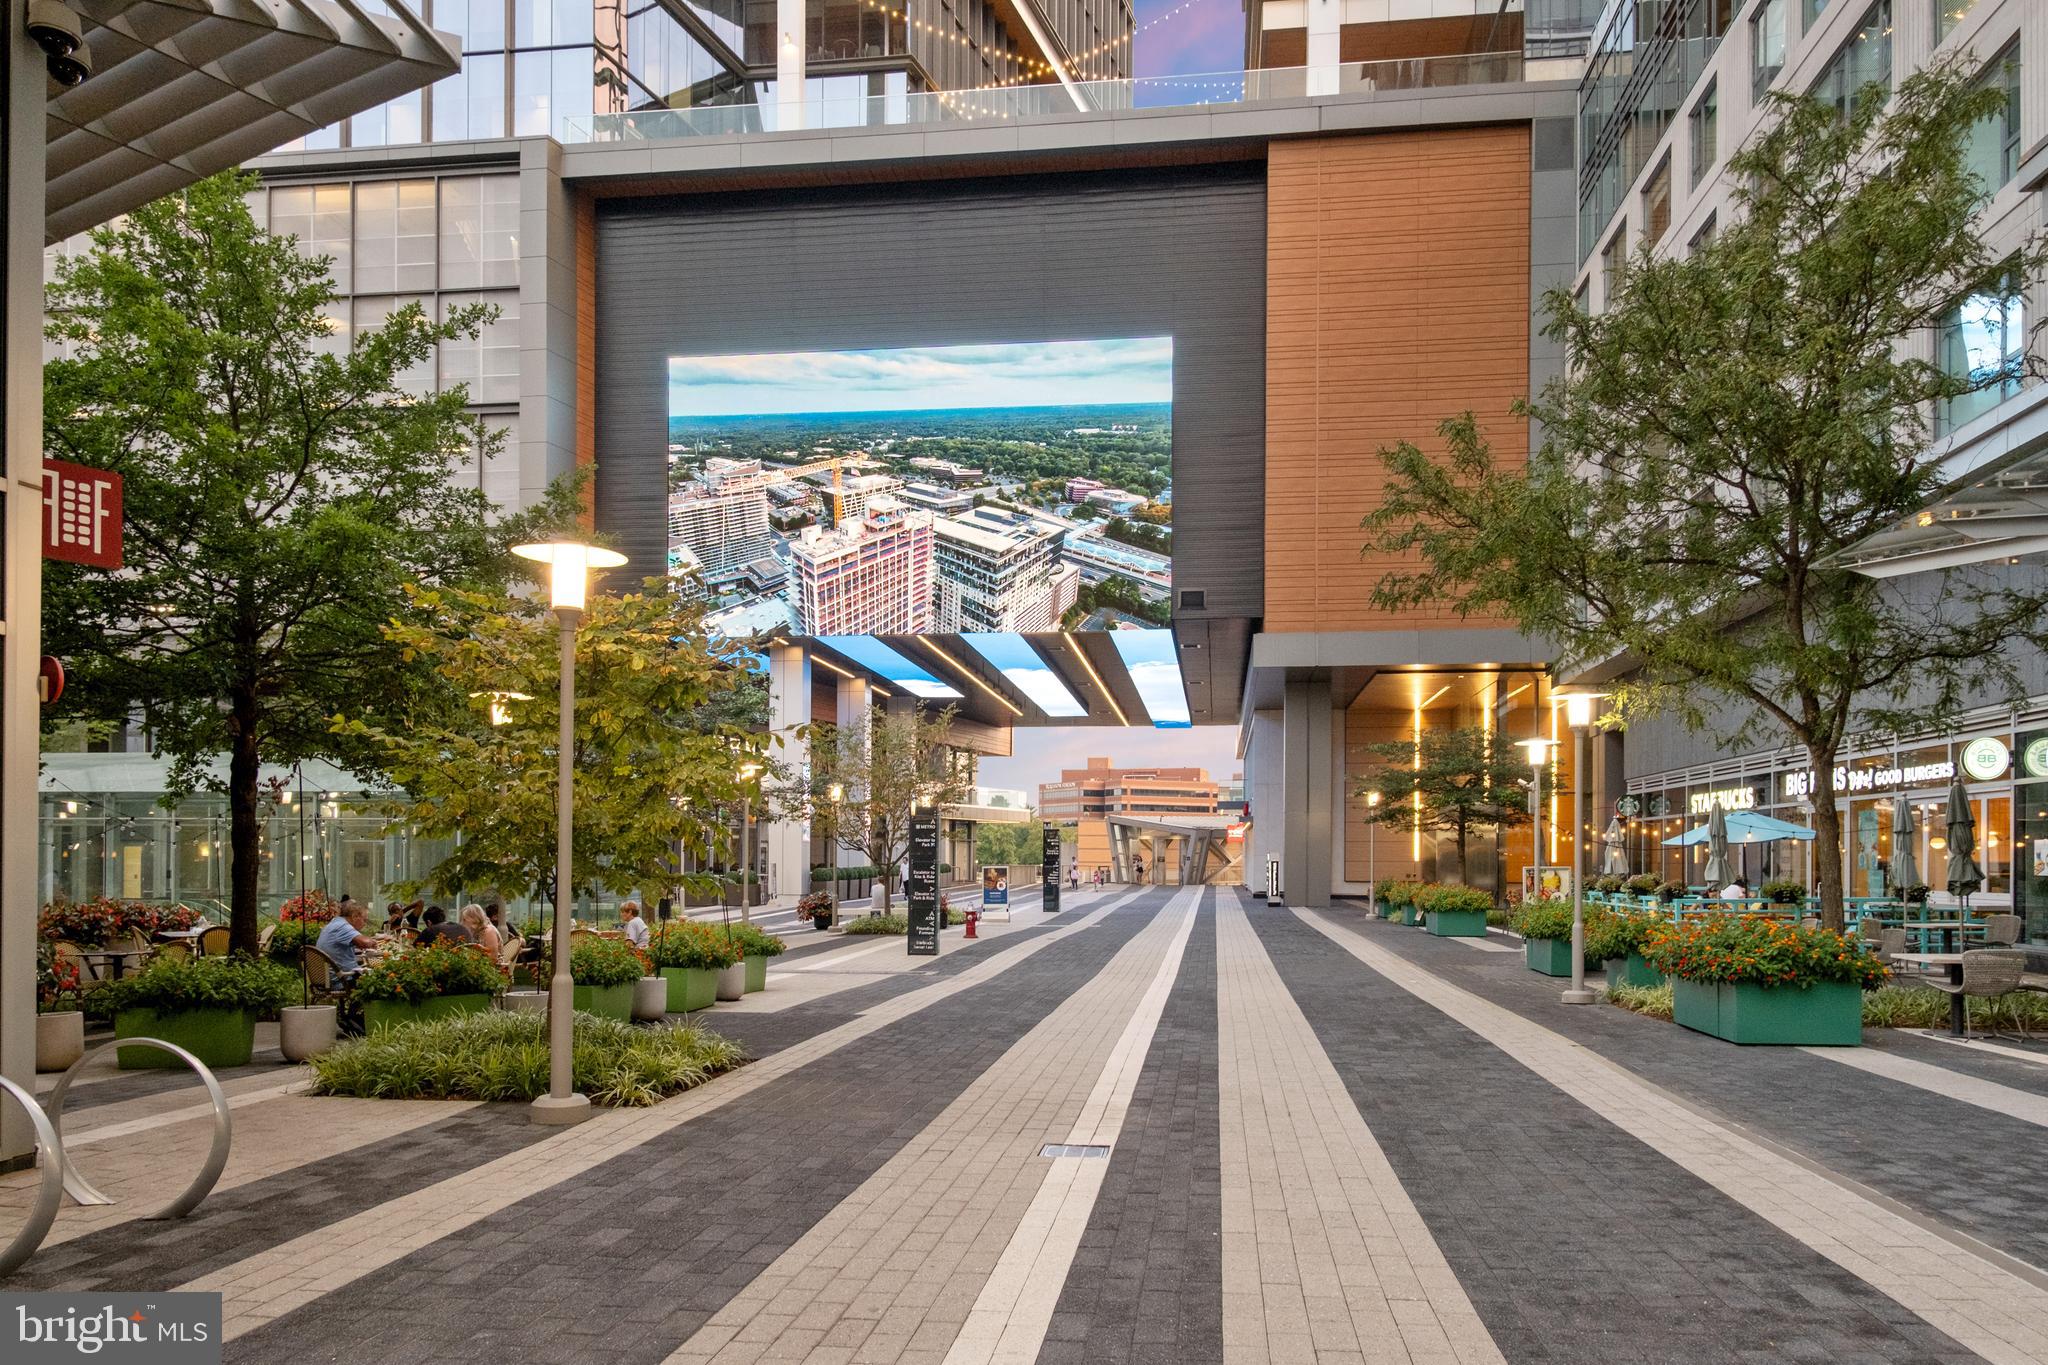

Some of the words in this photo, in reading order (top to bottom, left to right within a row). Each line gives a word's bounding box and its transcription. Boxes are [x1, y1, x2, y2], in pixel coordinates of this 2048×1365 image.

[1786, 772, 1807, 796] BIG
[1875, 769, 1902, 785] GOOD
[1904, 762, 1954, 783] BURGERS
